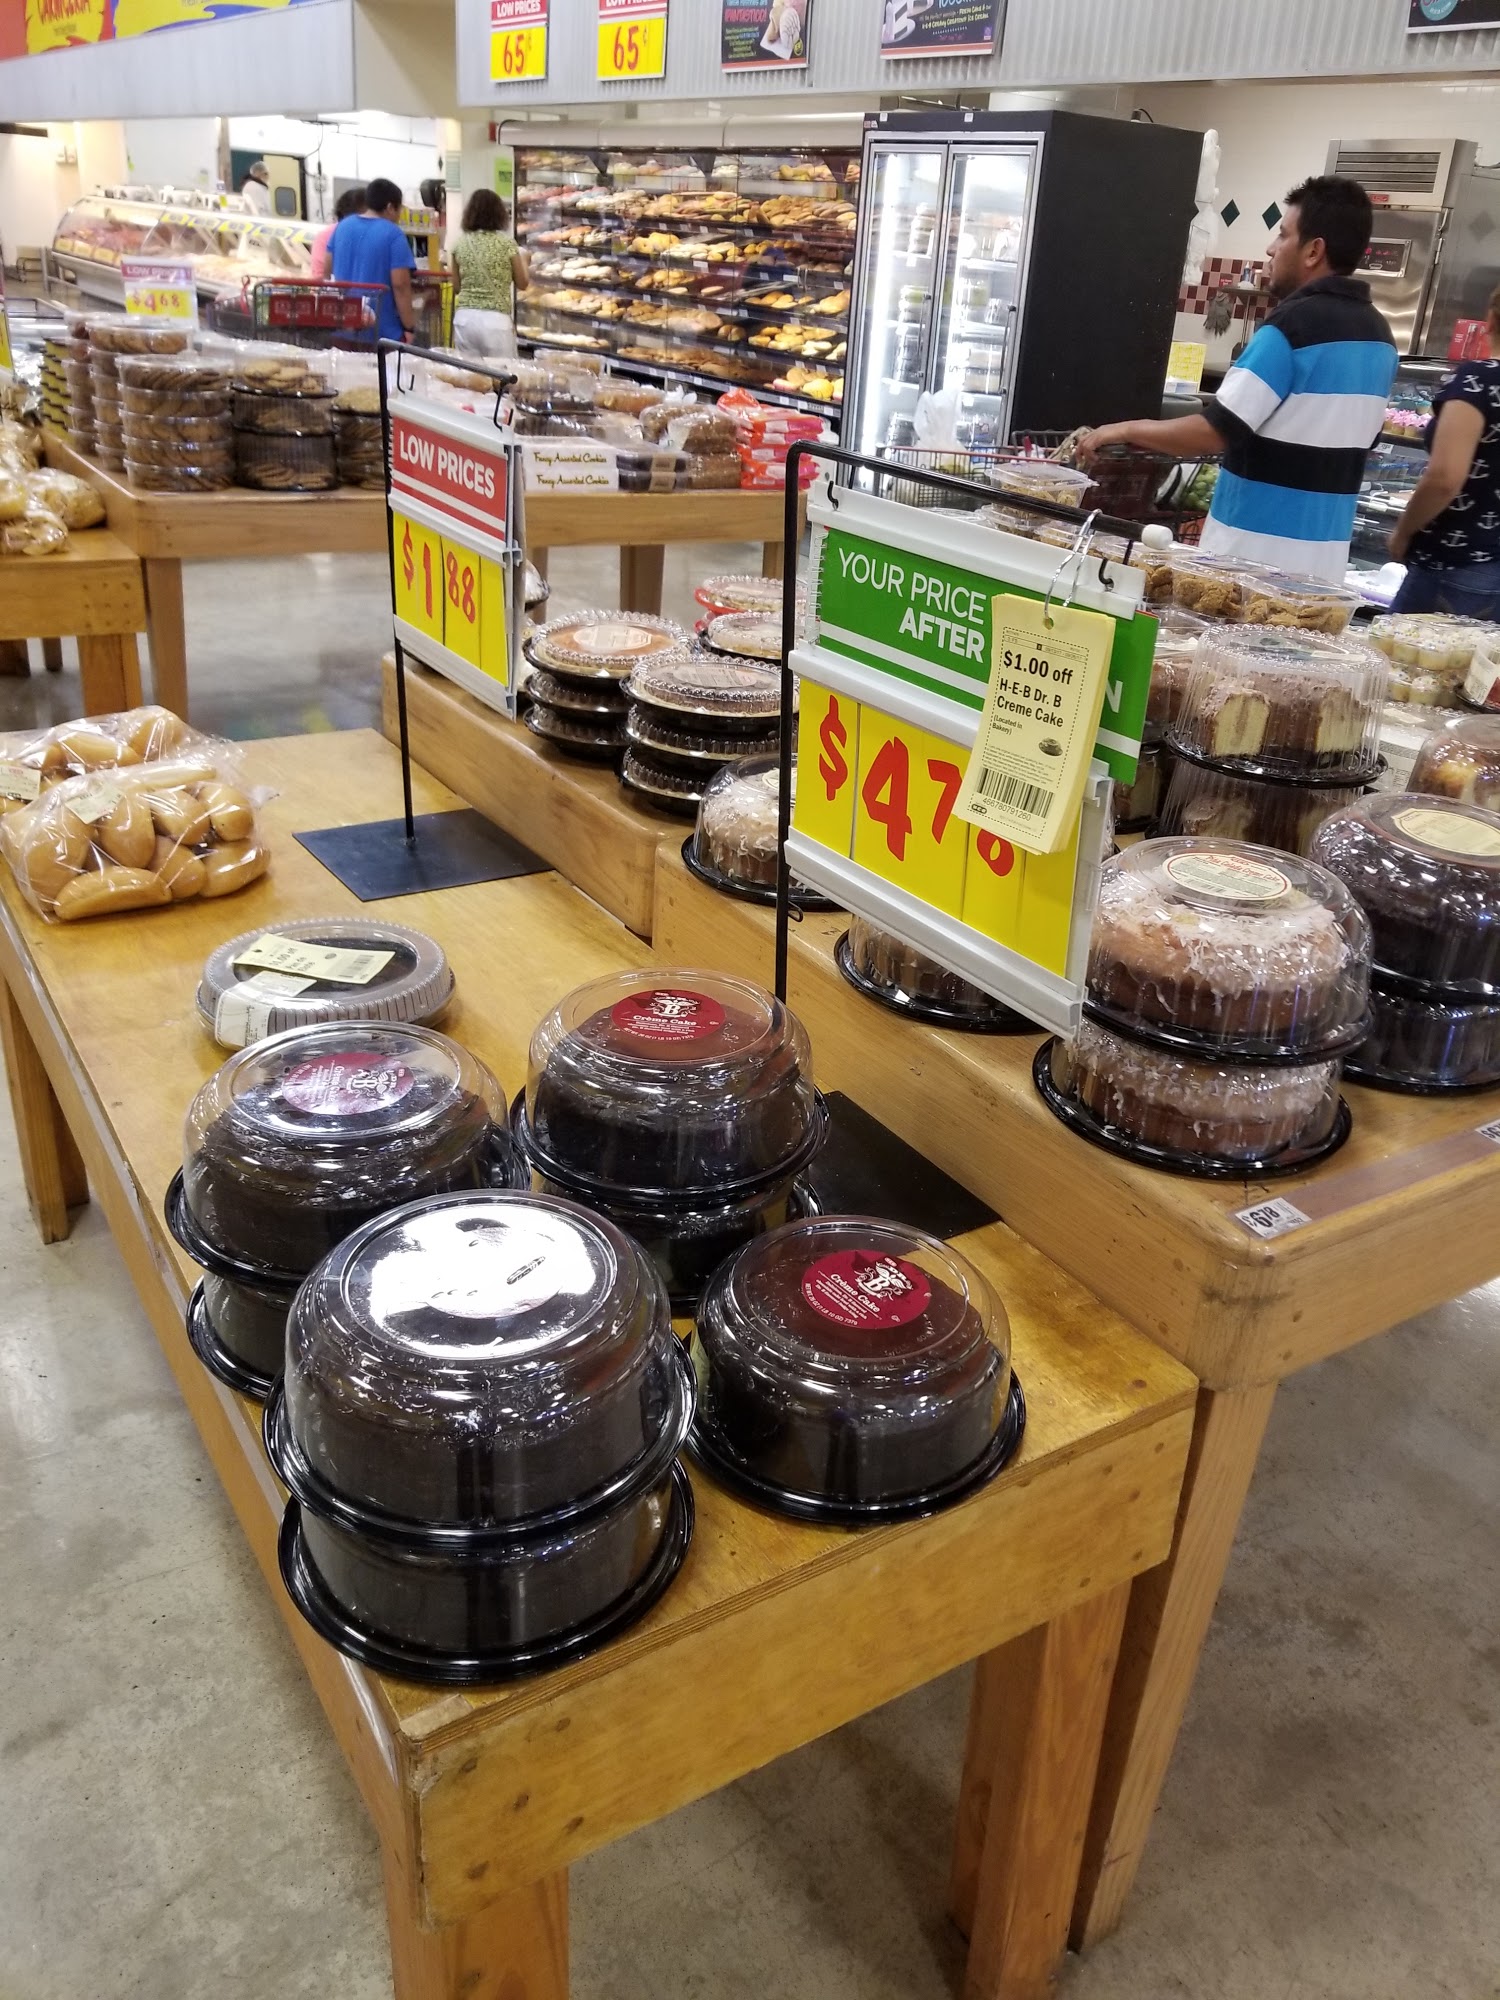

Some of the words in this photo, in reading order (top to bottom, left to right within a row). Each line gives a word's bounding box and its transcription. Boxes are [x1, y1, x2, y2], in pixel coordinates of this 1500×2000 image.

[496, 4, 514, 17] LOW
[515, 0, 541, 14] PRICES
[400, 430, 434, 472] LOW
[437, 446, 495, 500] PRICES
[534, 452, 552, 466] Fancy
[583, 452, 607, 463] Cookies
[536, 474, 556, 488] Fancy
[586, 474, 609, 485] Cookies
[838, 547, 905, 598] YOUR
[910, 570, 986, 625] PRICE
[898, 607, 986, 664] AFTER
[1004, 650, 1049, 678] $1.00
[1052, 668, 1073, 684] off
[1000, 678, 1031, 698] H-E-B
[1034, 688, 1049, 704] Dr.
[1053, 694, 1062, 708] B
[994, 715, 1016, 727] (Located
[997, 696, 1032, 717] Creme
[1035, 708, 1063, 728] Cake
[992, 722, 1012, 735] Bakery)
[633, 1015, 668, 1023] Crème
[831, 1274, 858, 1296] Crème
[858, 1295, 880, 1312] Cake
